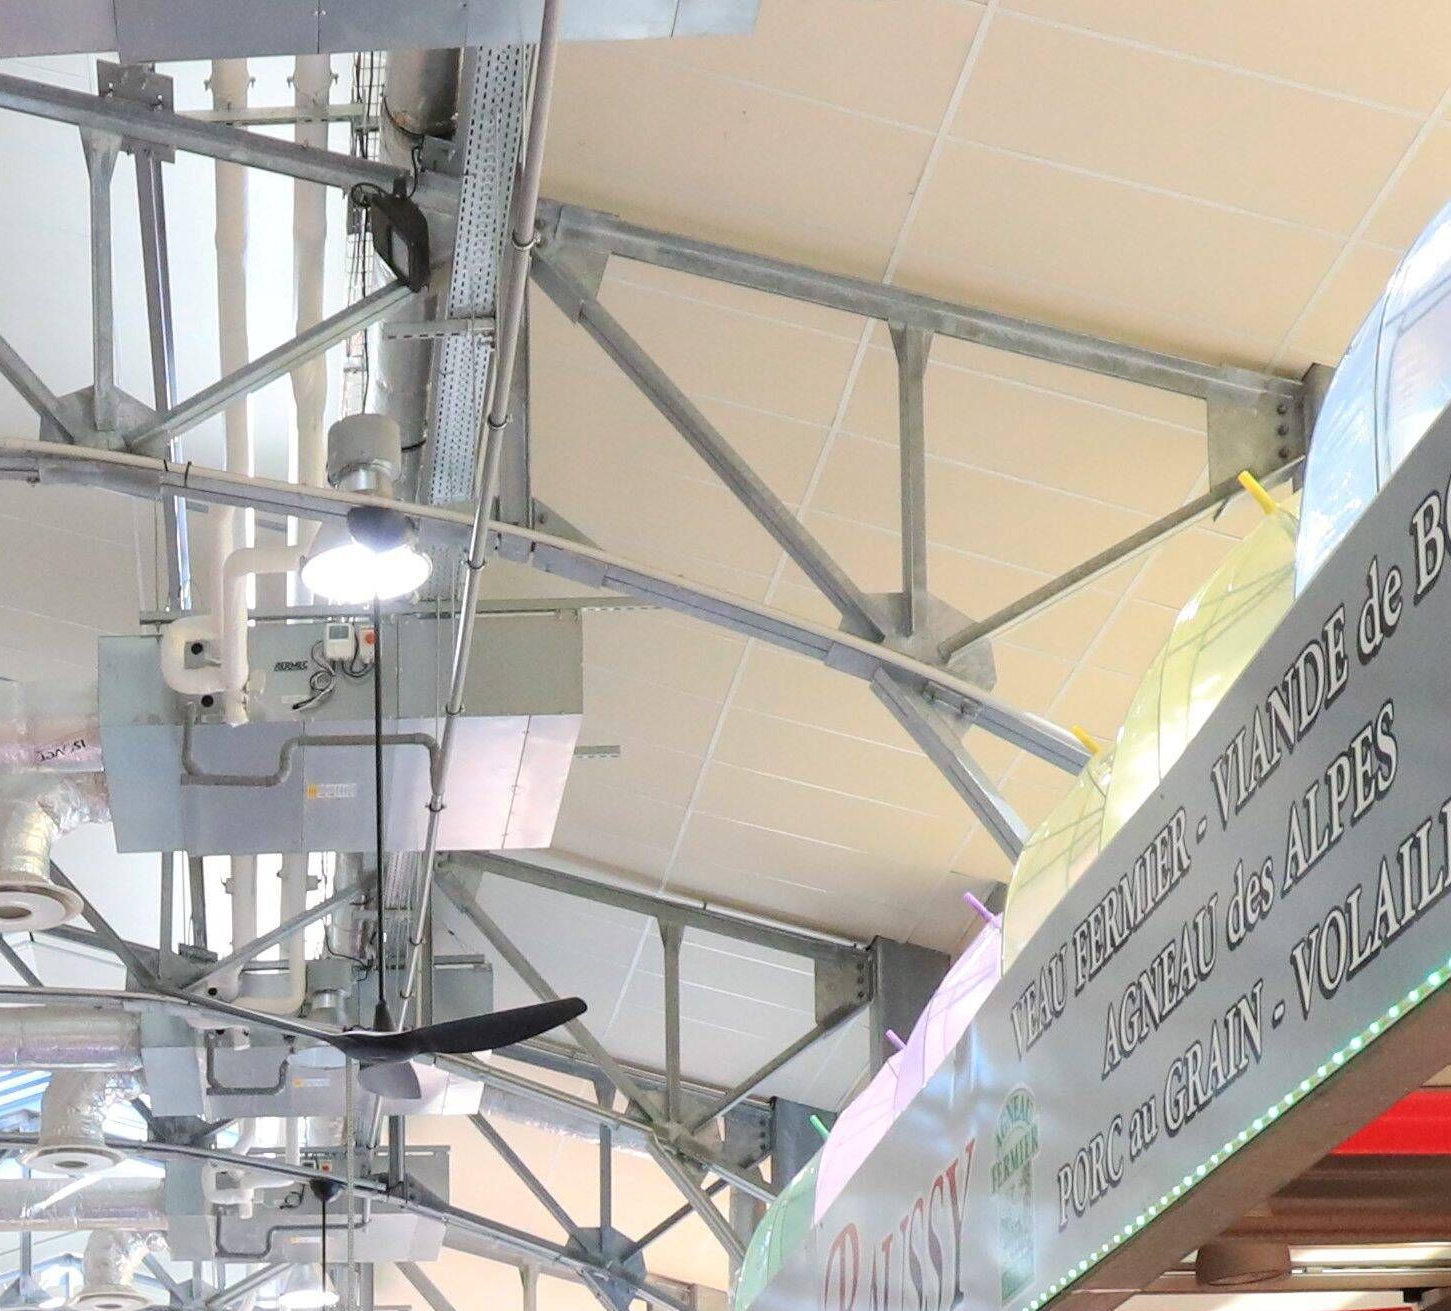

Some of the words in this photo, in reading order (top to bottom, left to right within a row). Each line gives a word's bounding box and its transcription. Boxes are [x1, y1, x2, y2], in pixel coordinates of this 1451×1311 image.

[1010, 940, 1067, 1061] VEAU
[1072, 814, 1190, 977] FERMIER
[1210, 605, 1348, 818] VIANDE
[1356, 556, 1402, 654] de
[1101, 895, 1218, 1080] AGNEAU
[1226, 856, 1275, 950] des
[1281, 700, 1400, 899] ALPES
[1058, 1111, 1124, 1228] PORC
[1128, 1093, 1159, 1157] au
[1163, 983, 1264, 1138] GRAIN
